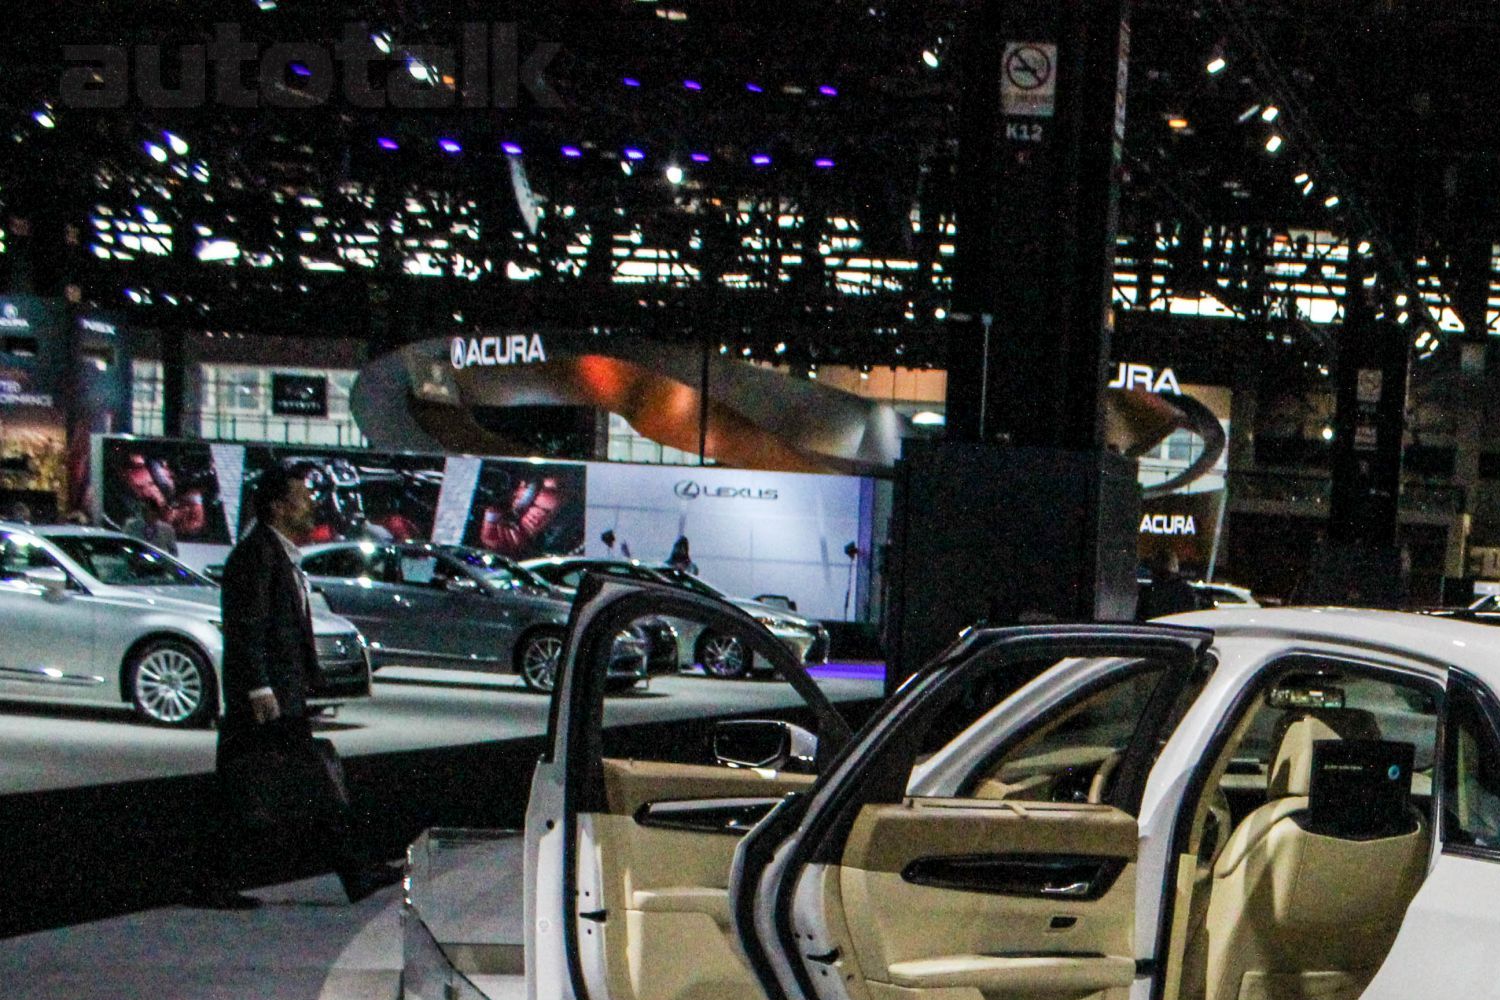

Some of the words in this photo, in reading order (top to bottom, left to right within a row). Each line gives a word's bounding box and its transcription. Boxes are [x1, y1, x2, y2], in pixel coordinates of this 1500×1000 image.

[1006, 123, 1043, 142] K12
[465, 333, 547, 367] ACURA
[1107, 362, 1182, 396] URA
[703, 485, 779, 500] LEXUS
[1139, 512, 1196, 535] ACURA
